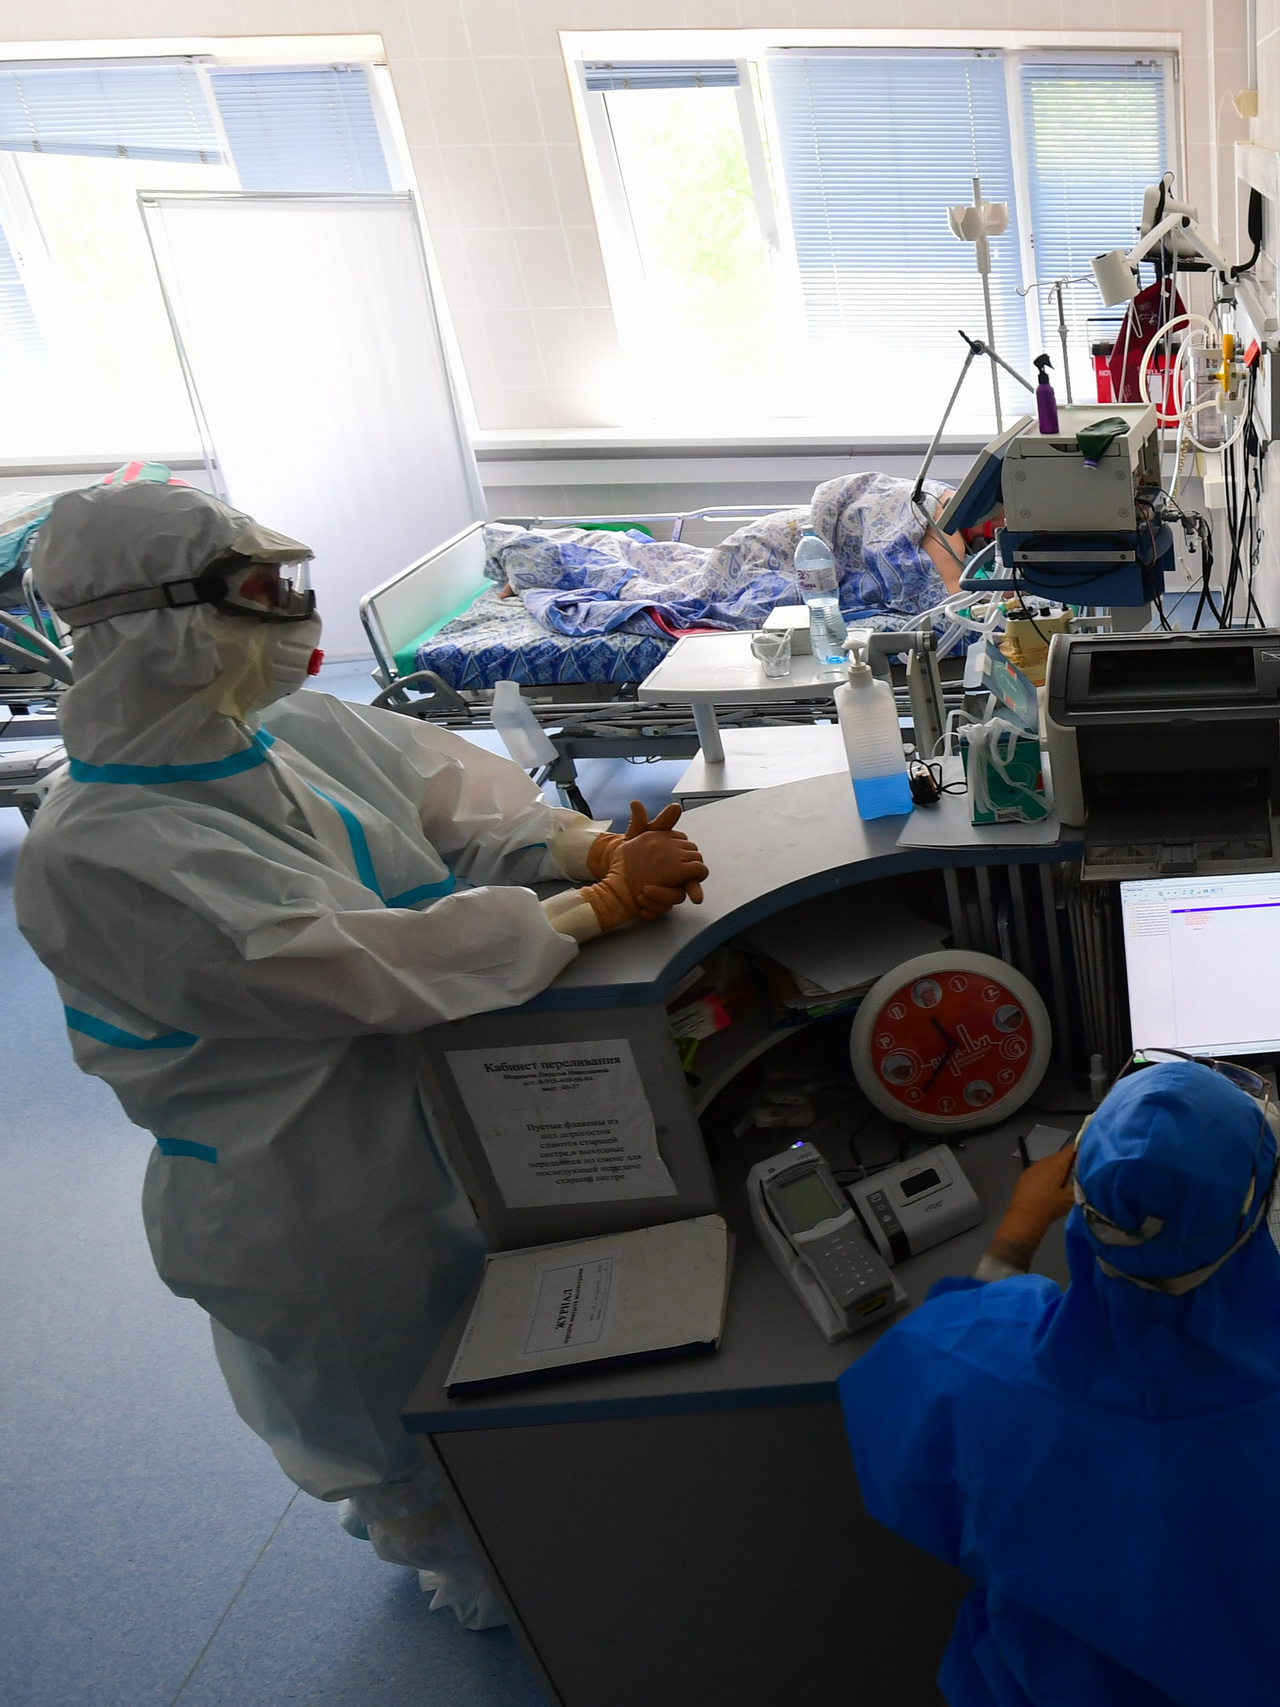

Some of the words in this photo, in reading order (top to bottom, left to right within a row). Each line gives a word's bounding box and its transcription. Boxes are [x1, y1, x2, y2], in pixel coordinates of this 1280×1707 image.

[484, 1062, 537, 1072] Кабинет
[541, 1056, 621, 1070] переливания
[526, 1123, 562, 1133] Пустые
[565, 1120, 605, 1130] флаконы
[579, 1137, 618, 1146] старшей
[579, 1147, 624, 1155] выходные
[555, 1288, 573, 1330] ЖУРНАЛ
